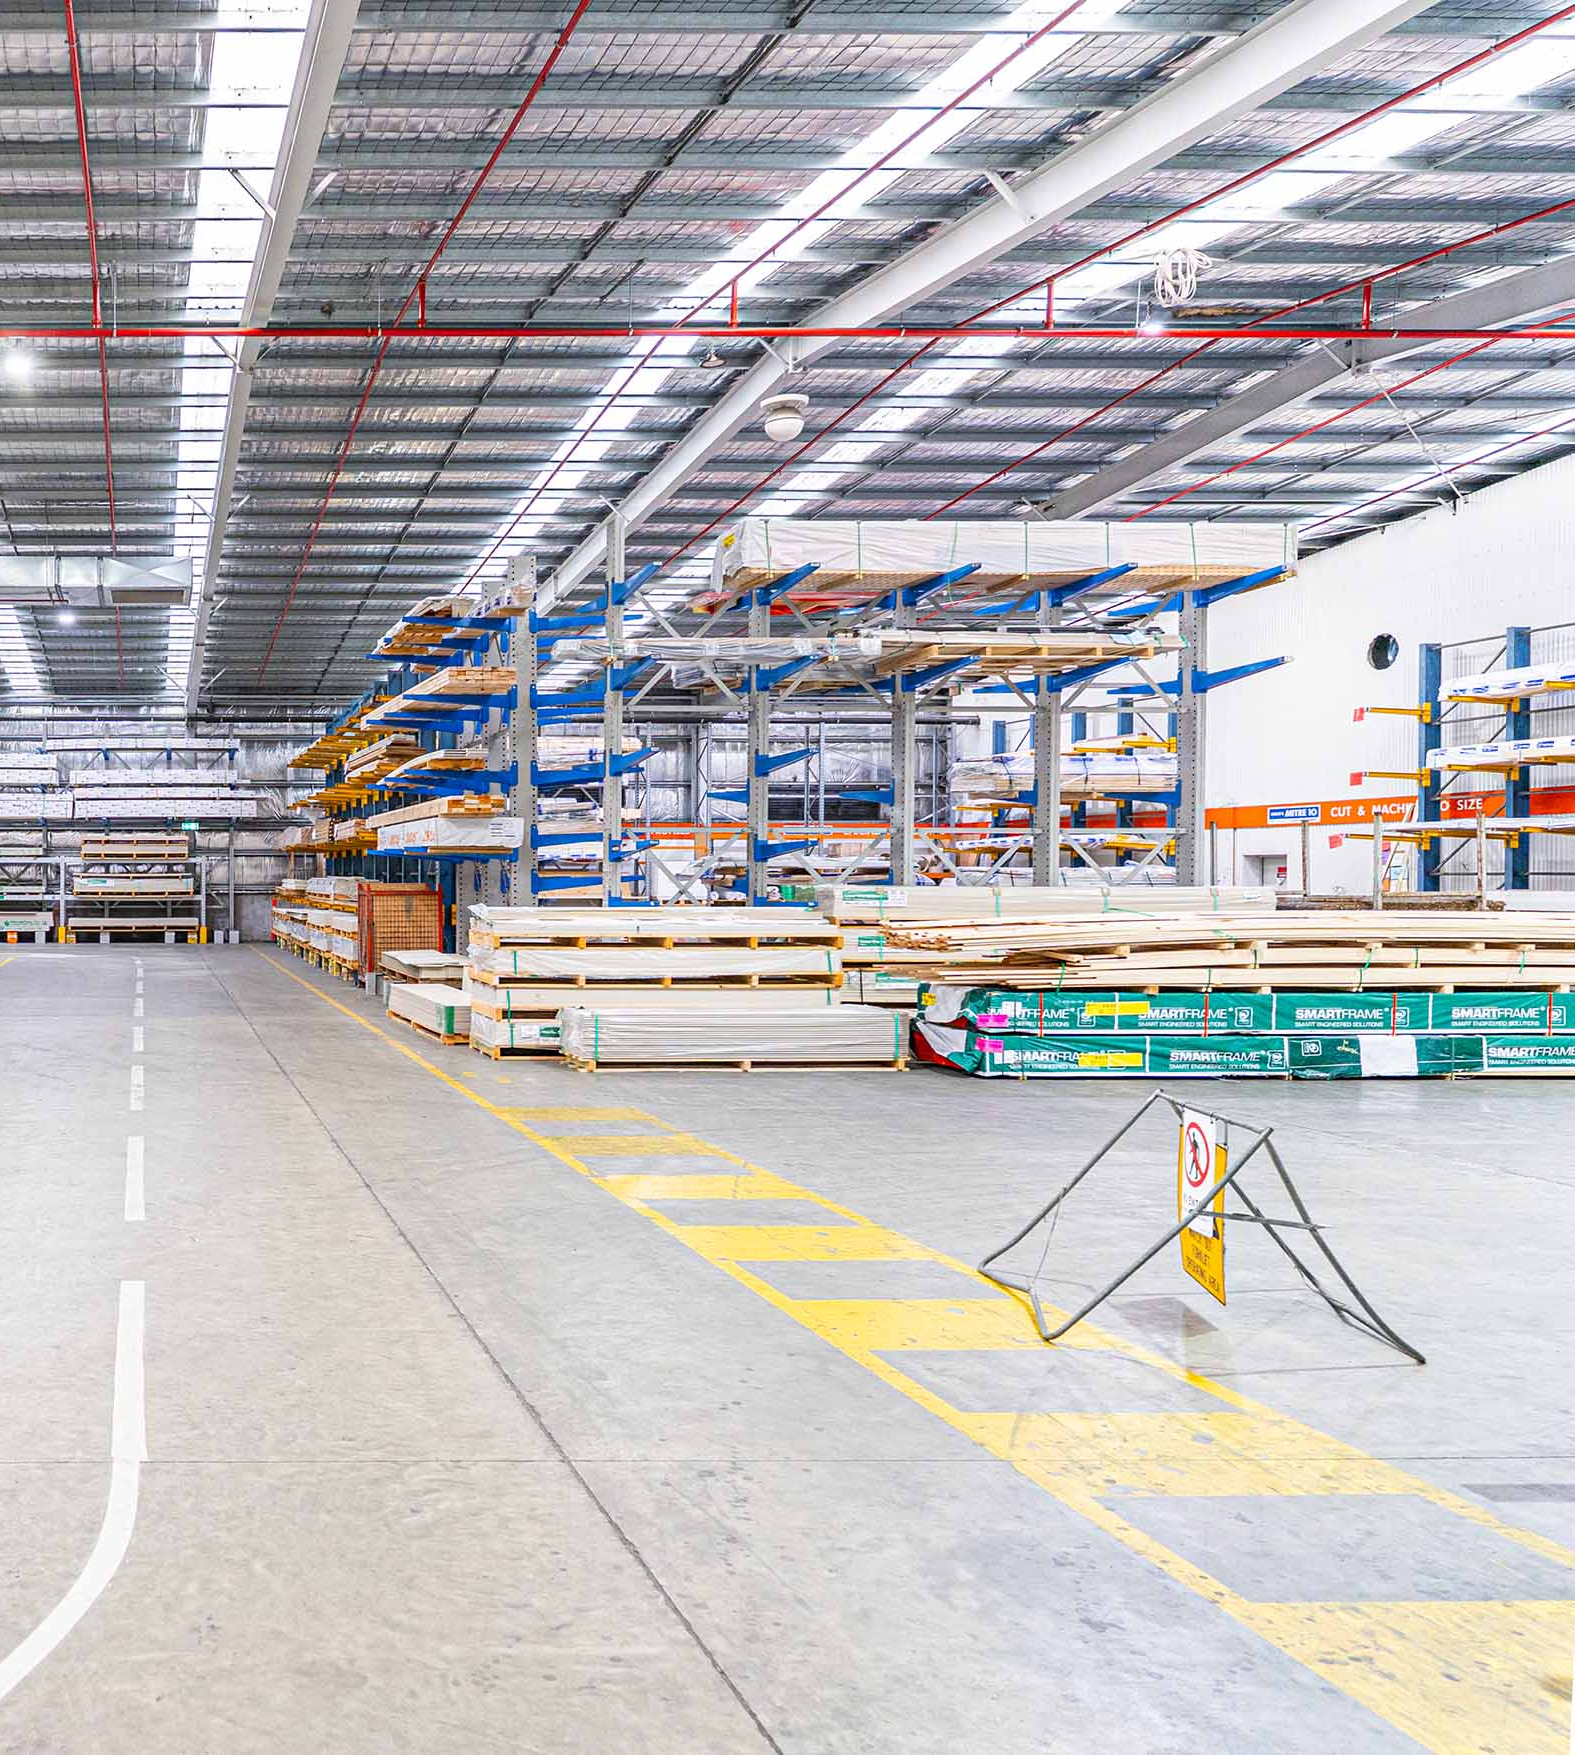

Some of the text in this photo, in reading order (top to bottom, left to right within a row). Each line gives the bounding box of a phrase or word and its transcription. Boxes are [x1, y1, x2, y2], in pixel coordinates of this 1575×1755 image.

[1308, 808, 1317, 816] 10
[1330, 806, 1352, 817] CUT
[1357, 805, 1365, 816] &
[1457, 799, 1483, 811] SIZE
[1295, 1008, 1383, 1020] SMARTFRAME
[1451, 1007, 1539, 1019] SMARTFRAME
[1169, 1051, 1260, 1062] SMARTFRAME
